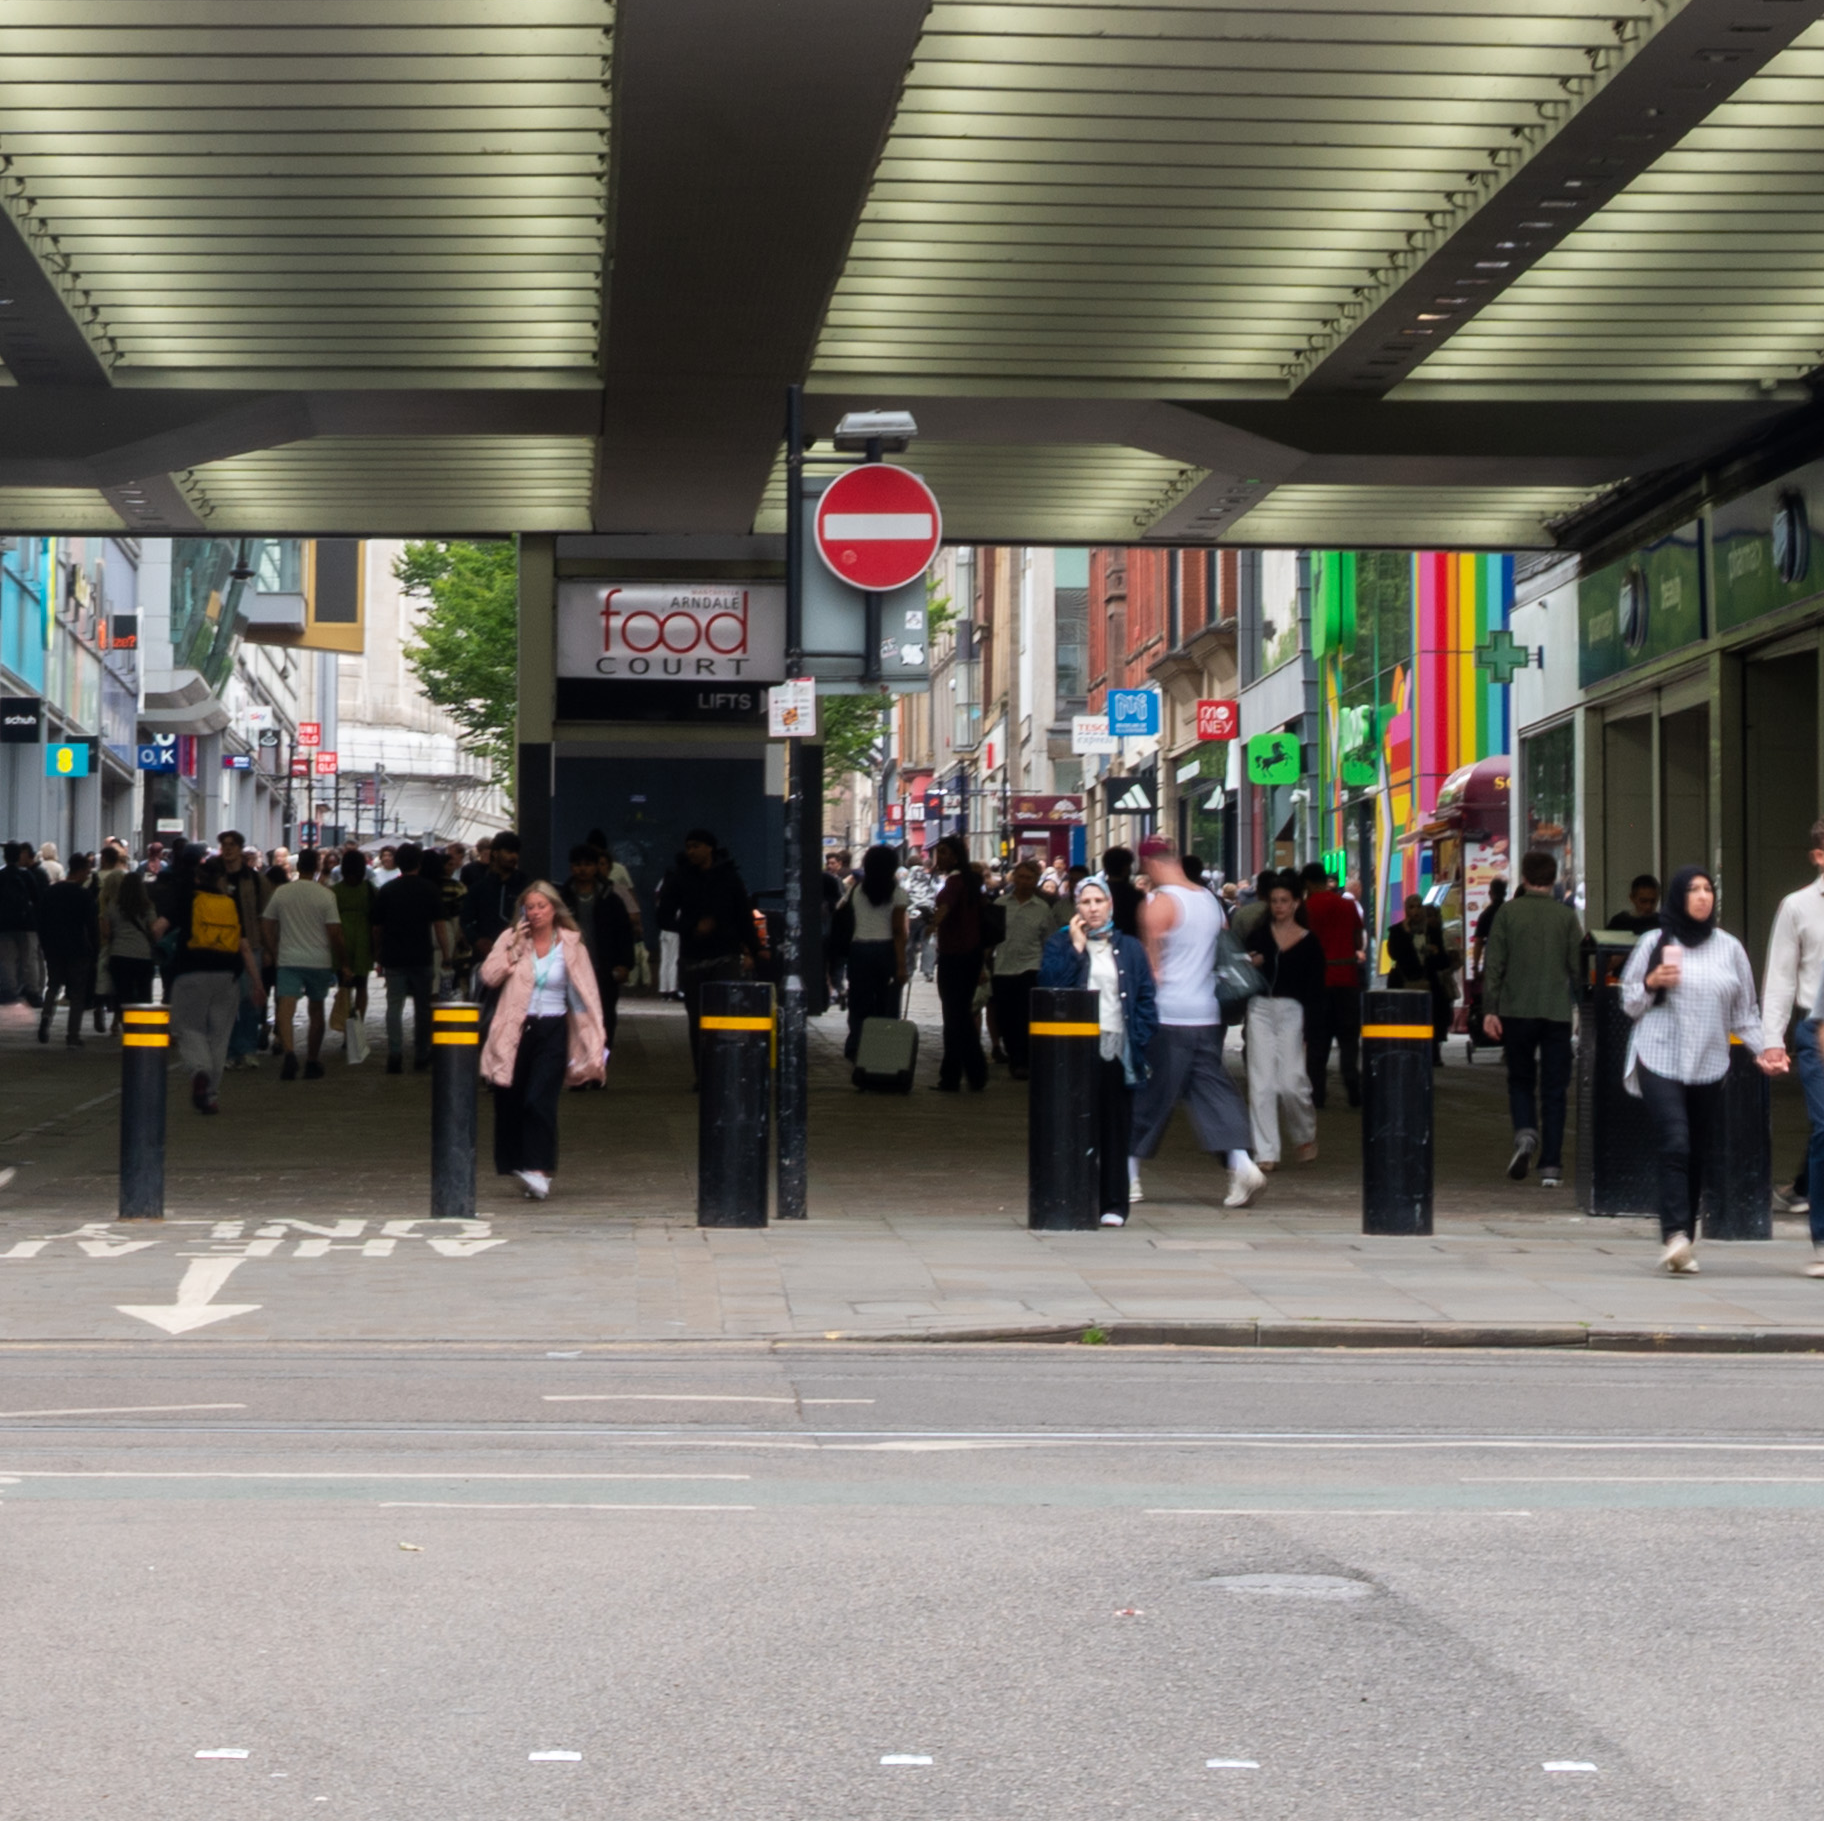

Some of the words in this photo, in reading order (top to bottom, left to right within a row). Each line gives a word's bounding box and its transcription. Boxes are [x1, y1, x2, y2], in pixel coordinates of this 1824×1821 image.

[670, 596, 740, 610] ARNDALE
[600, 588, 749, 655] food
[595, 657, 750, 676] COURT
[698, 693, 752, 710] LIFTS
[4, 715, 37, 725] schuh
